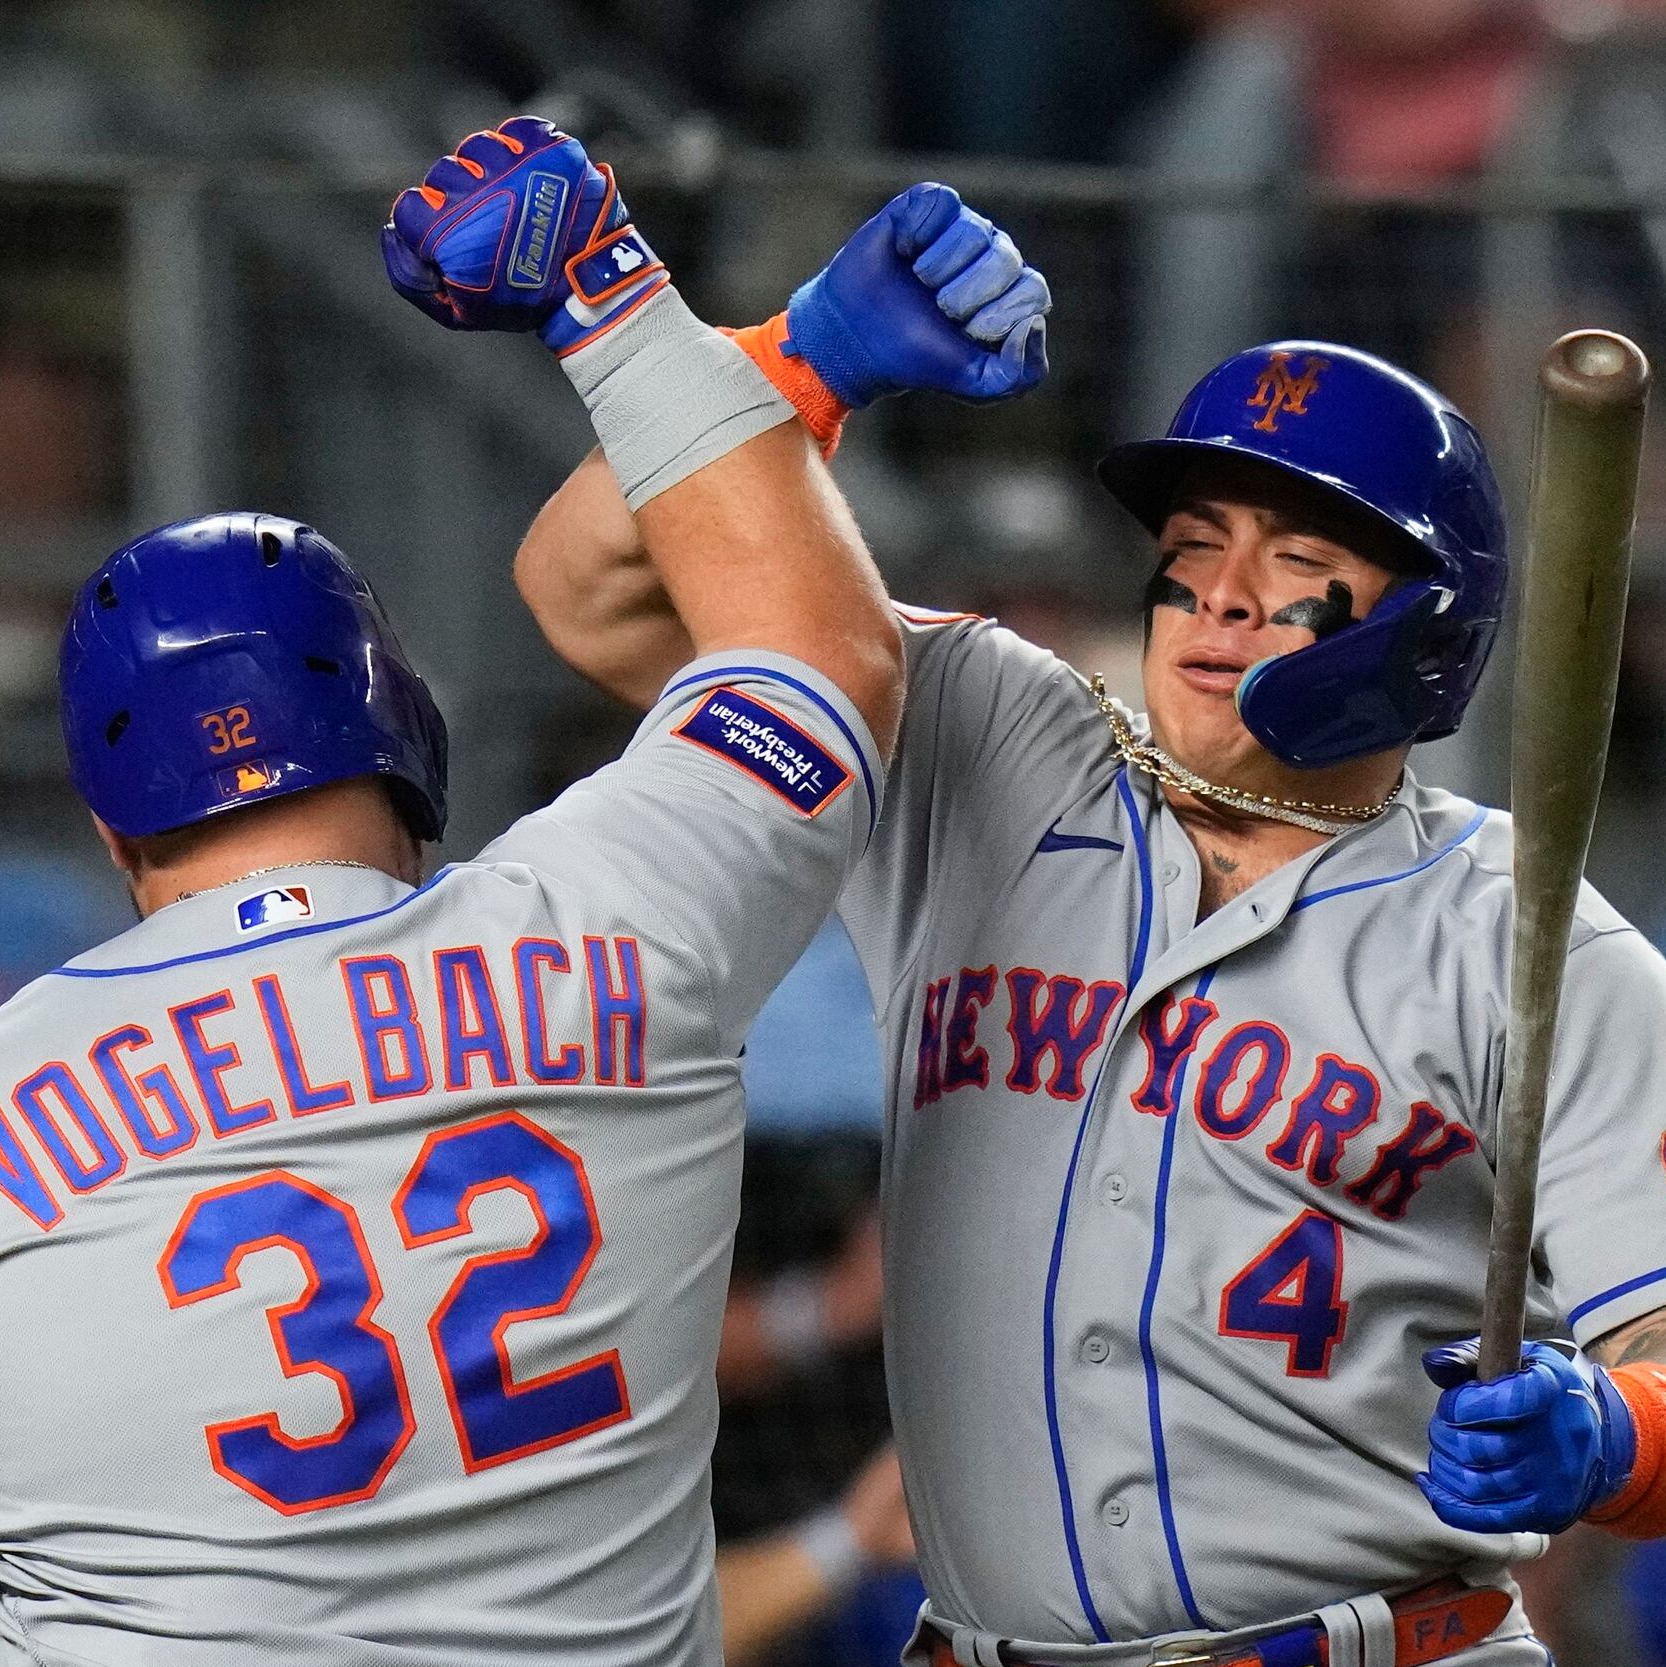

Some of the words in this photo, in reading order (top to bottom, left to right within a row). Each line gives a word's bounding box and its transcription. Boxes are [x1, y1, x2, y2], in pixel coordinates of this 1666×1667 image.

[515, 178, 559, 283] Franklin
[201, 706, 257, 755] 32
[708, 702, 814, 774] Presbyterian
[721, 728, 802, 786] NewYork-
[913, 963, 1127, 1111] NEW
[1130, 991, 1476, 1221] YORK
[156, 1110, 632, 1518] 32
[1217, 1209, 1348, 1380] 4
